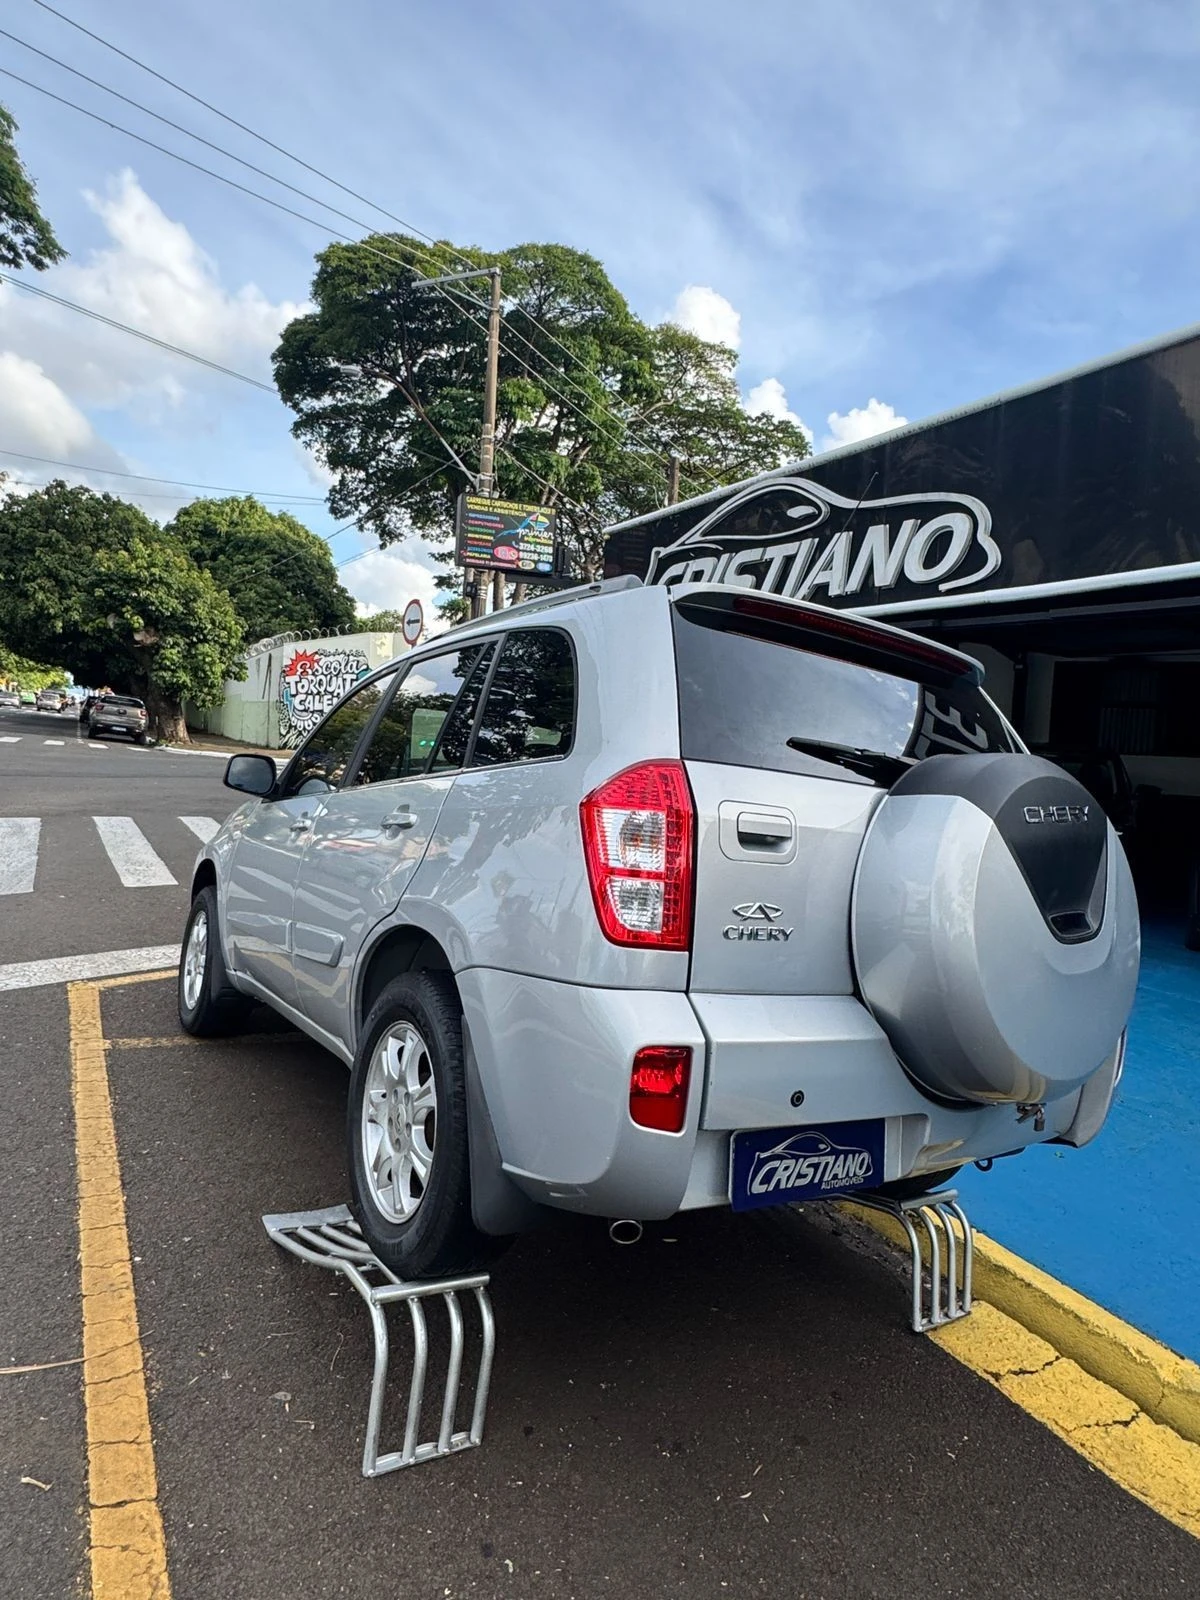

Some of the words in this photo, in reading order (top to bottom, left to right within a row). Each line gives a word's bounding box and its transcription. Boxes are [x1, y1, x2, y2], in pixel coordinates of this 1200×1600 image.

[467, 503, 488, 511] VENDAS
[296, 654, 368, 676] Escola
[1023, 805, 1089, 824] CHERY
[722, 925, 794, 942] CHERY
[751, 1152, 870, 1194] CRISTIANO
